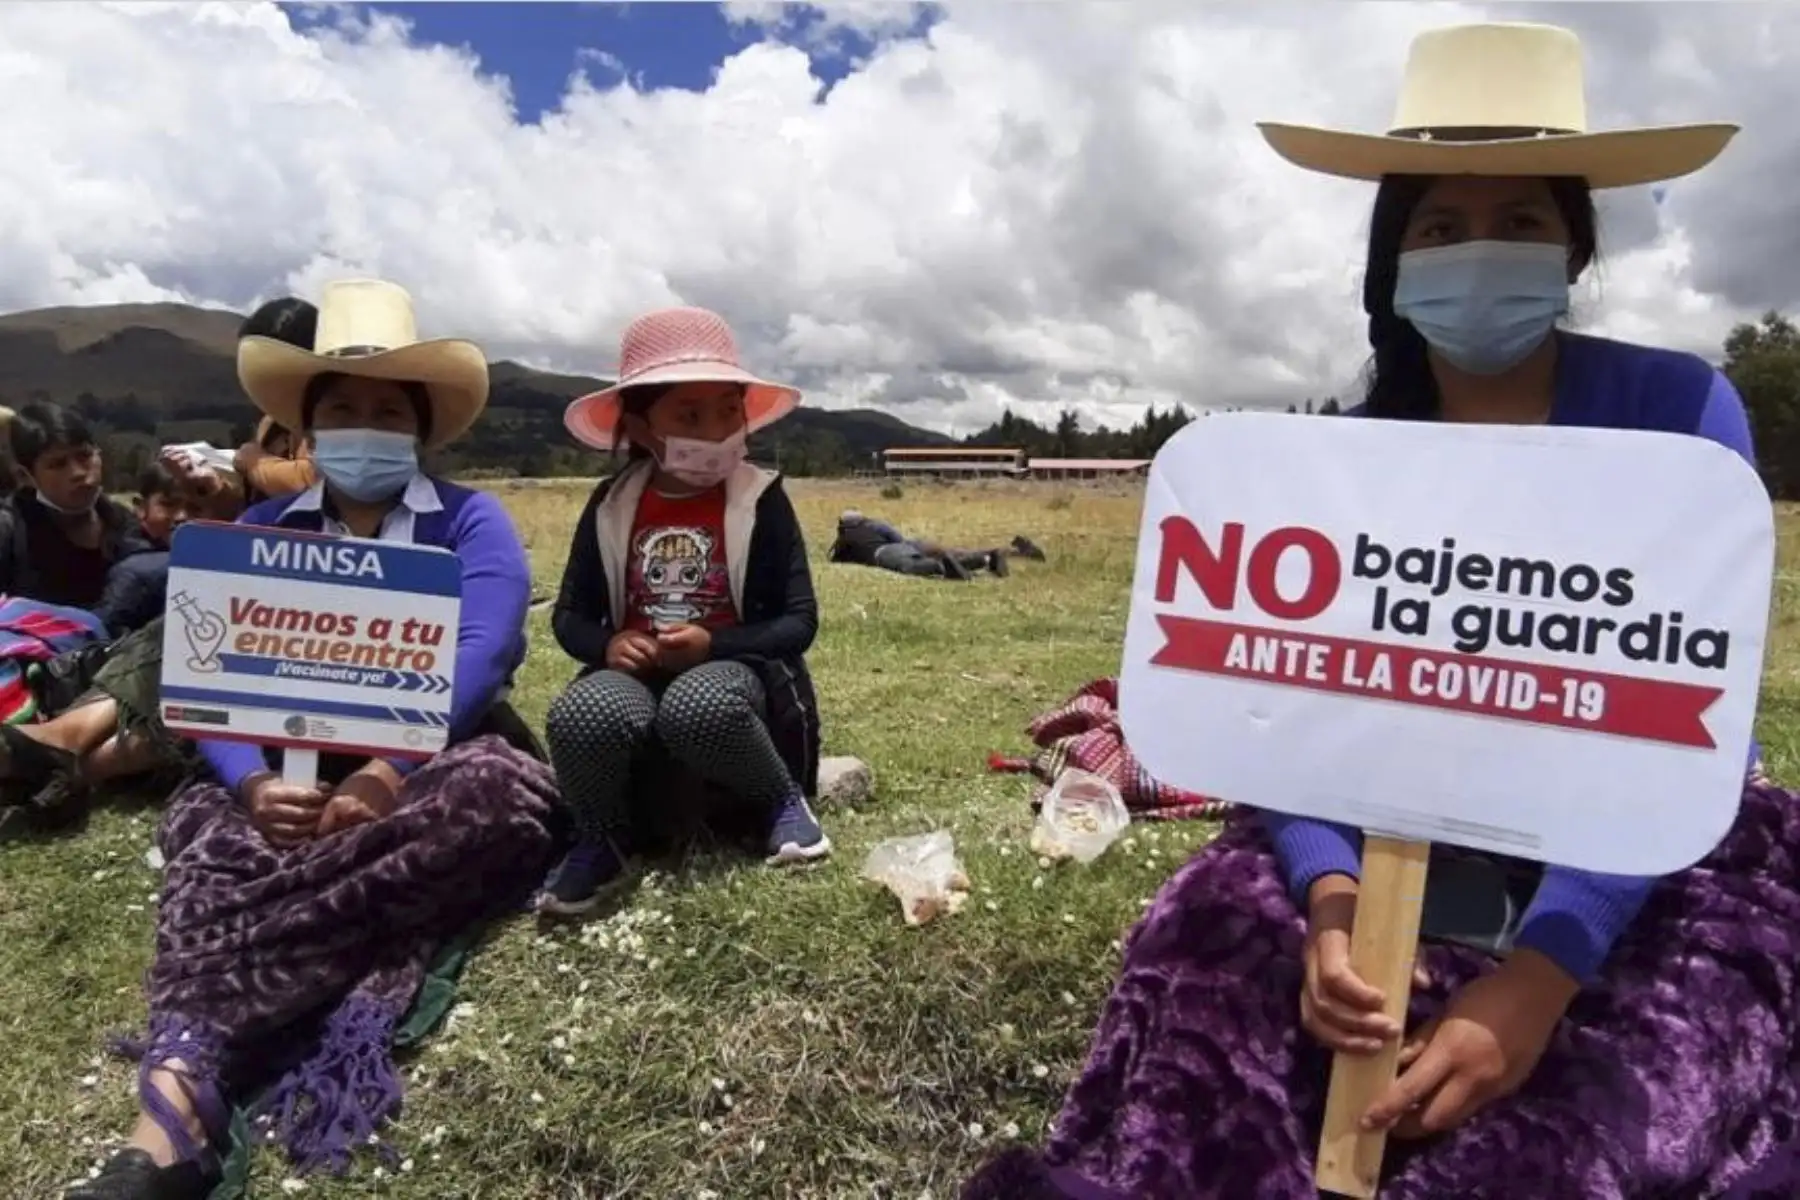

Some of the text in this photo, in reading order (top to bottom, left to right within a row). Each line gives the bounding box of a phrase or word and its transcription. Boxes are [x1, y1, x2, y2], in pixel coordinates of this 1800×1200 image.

[251, 538, 384, 579] MINSA
[1155, 515, 1634, 620] NO bajemos
[229, 597, 445, 646] Vamos a tu
[234, 631, 436, 671] encuentro
[1371, 587, 1729, 670] la guardia
[1225, 633, 1606, 721] ANTE LA COVID-19
